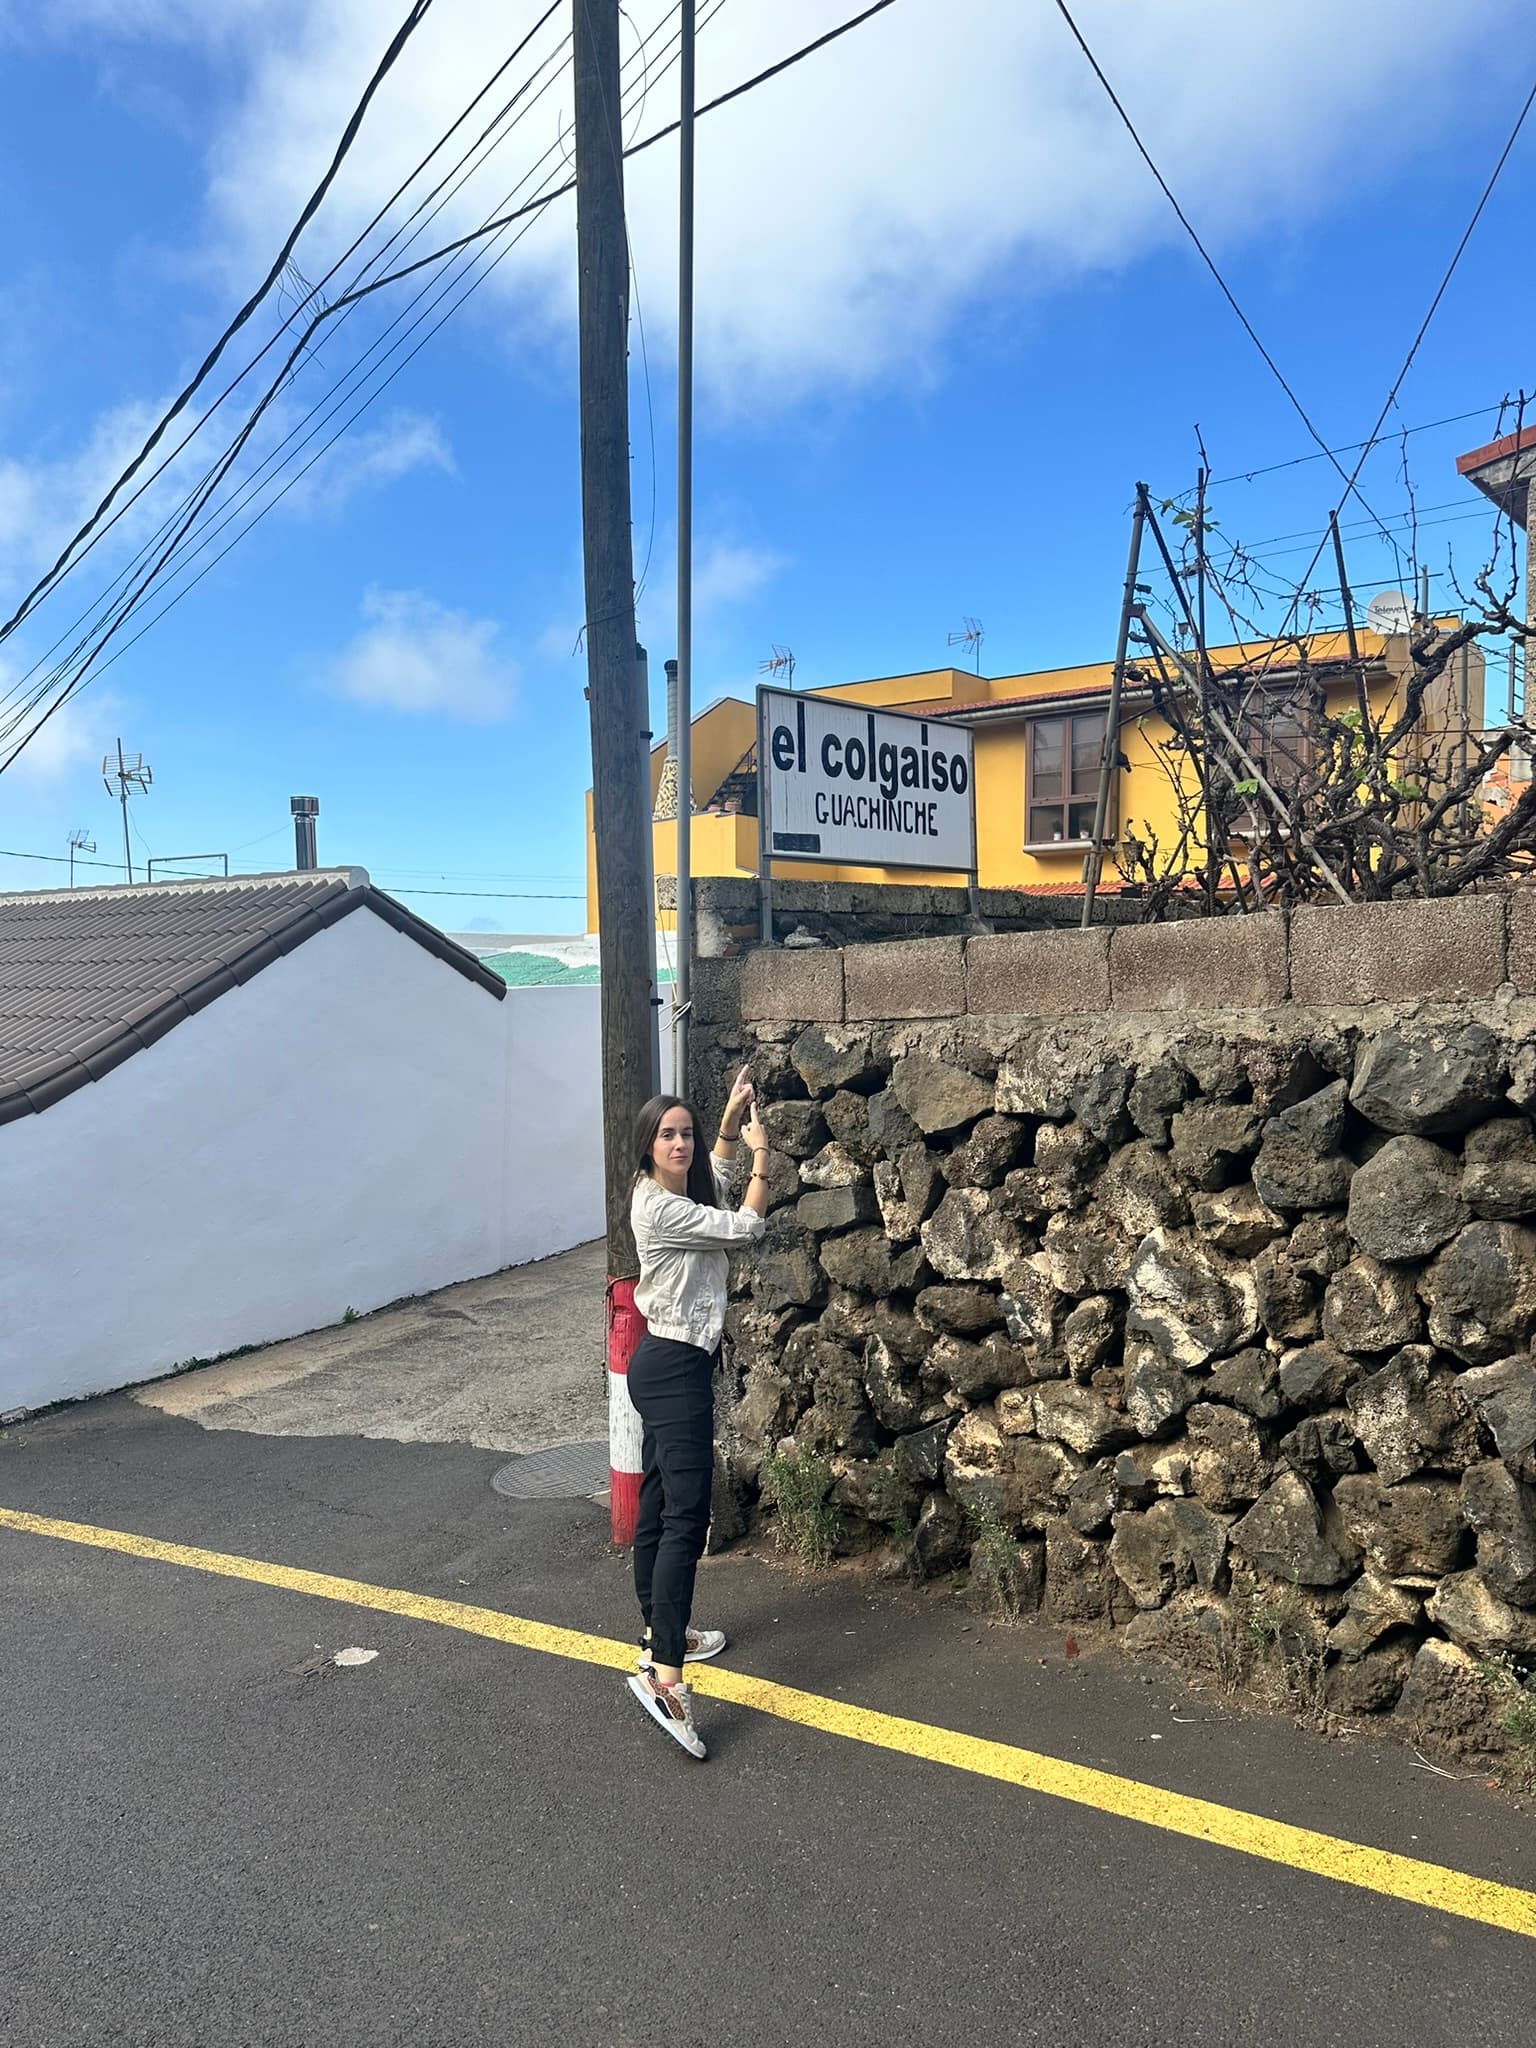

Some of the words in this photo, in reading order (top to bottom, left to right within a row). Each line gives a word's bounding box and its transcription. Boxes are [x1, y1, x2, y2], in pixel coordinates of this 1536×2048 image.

[772, 701, 806, 773] el
[821, 714, 968, 800] colgaiso
[815, 792, 938, 836] GUACHINCHE
